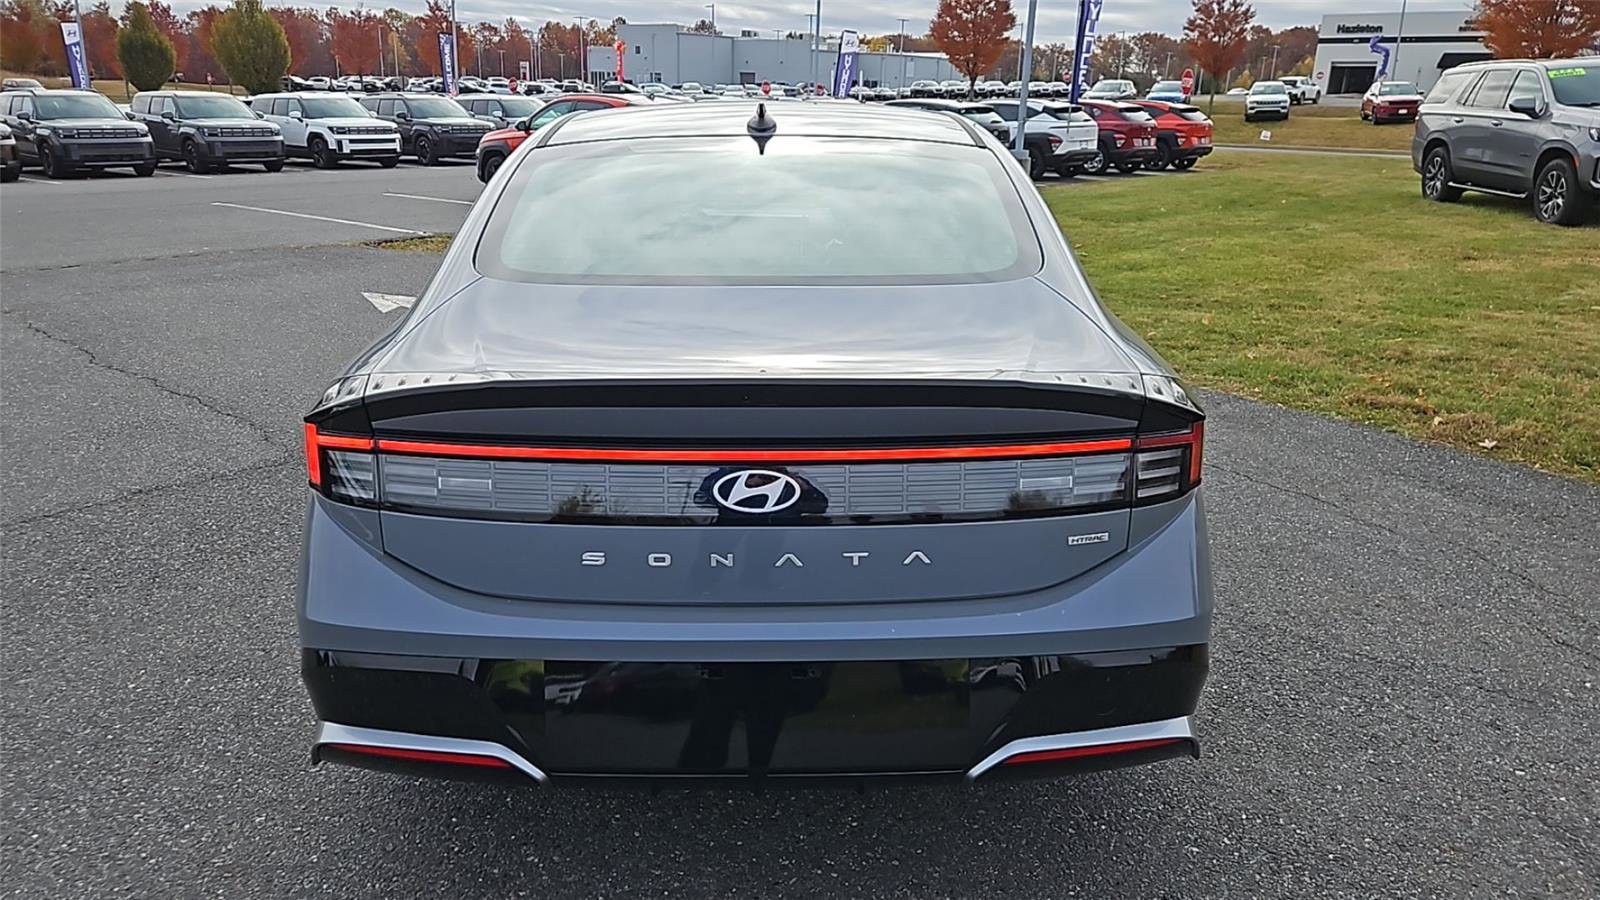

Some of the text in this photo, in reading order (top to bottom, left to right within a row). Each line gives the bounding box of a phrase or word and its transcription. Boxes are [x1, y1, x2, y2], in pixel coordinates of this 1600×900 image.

[1337, 24, 1383, 34] Hazleton
[1070, 534, 1108, 544] HTRAC
[581, 550, 932, 568] SONATA
